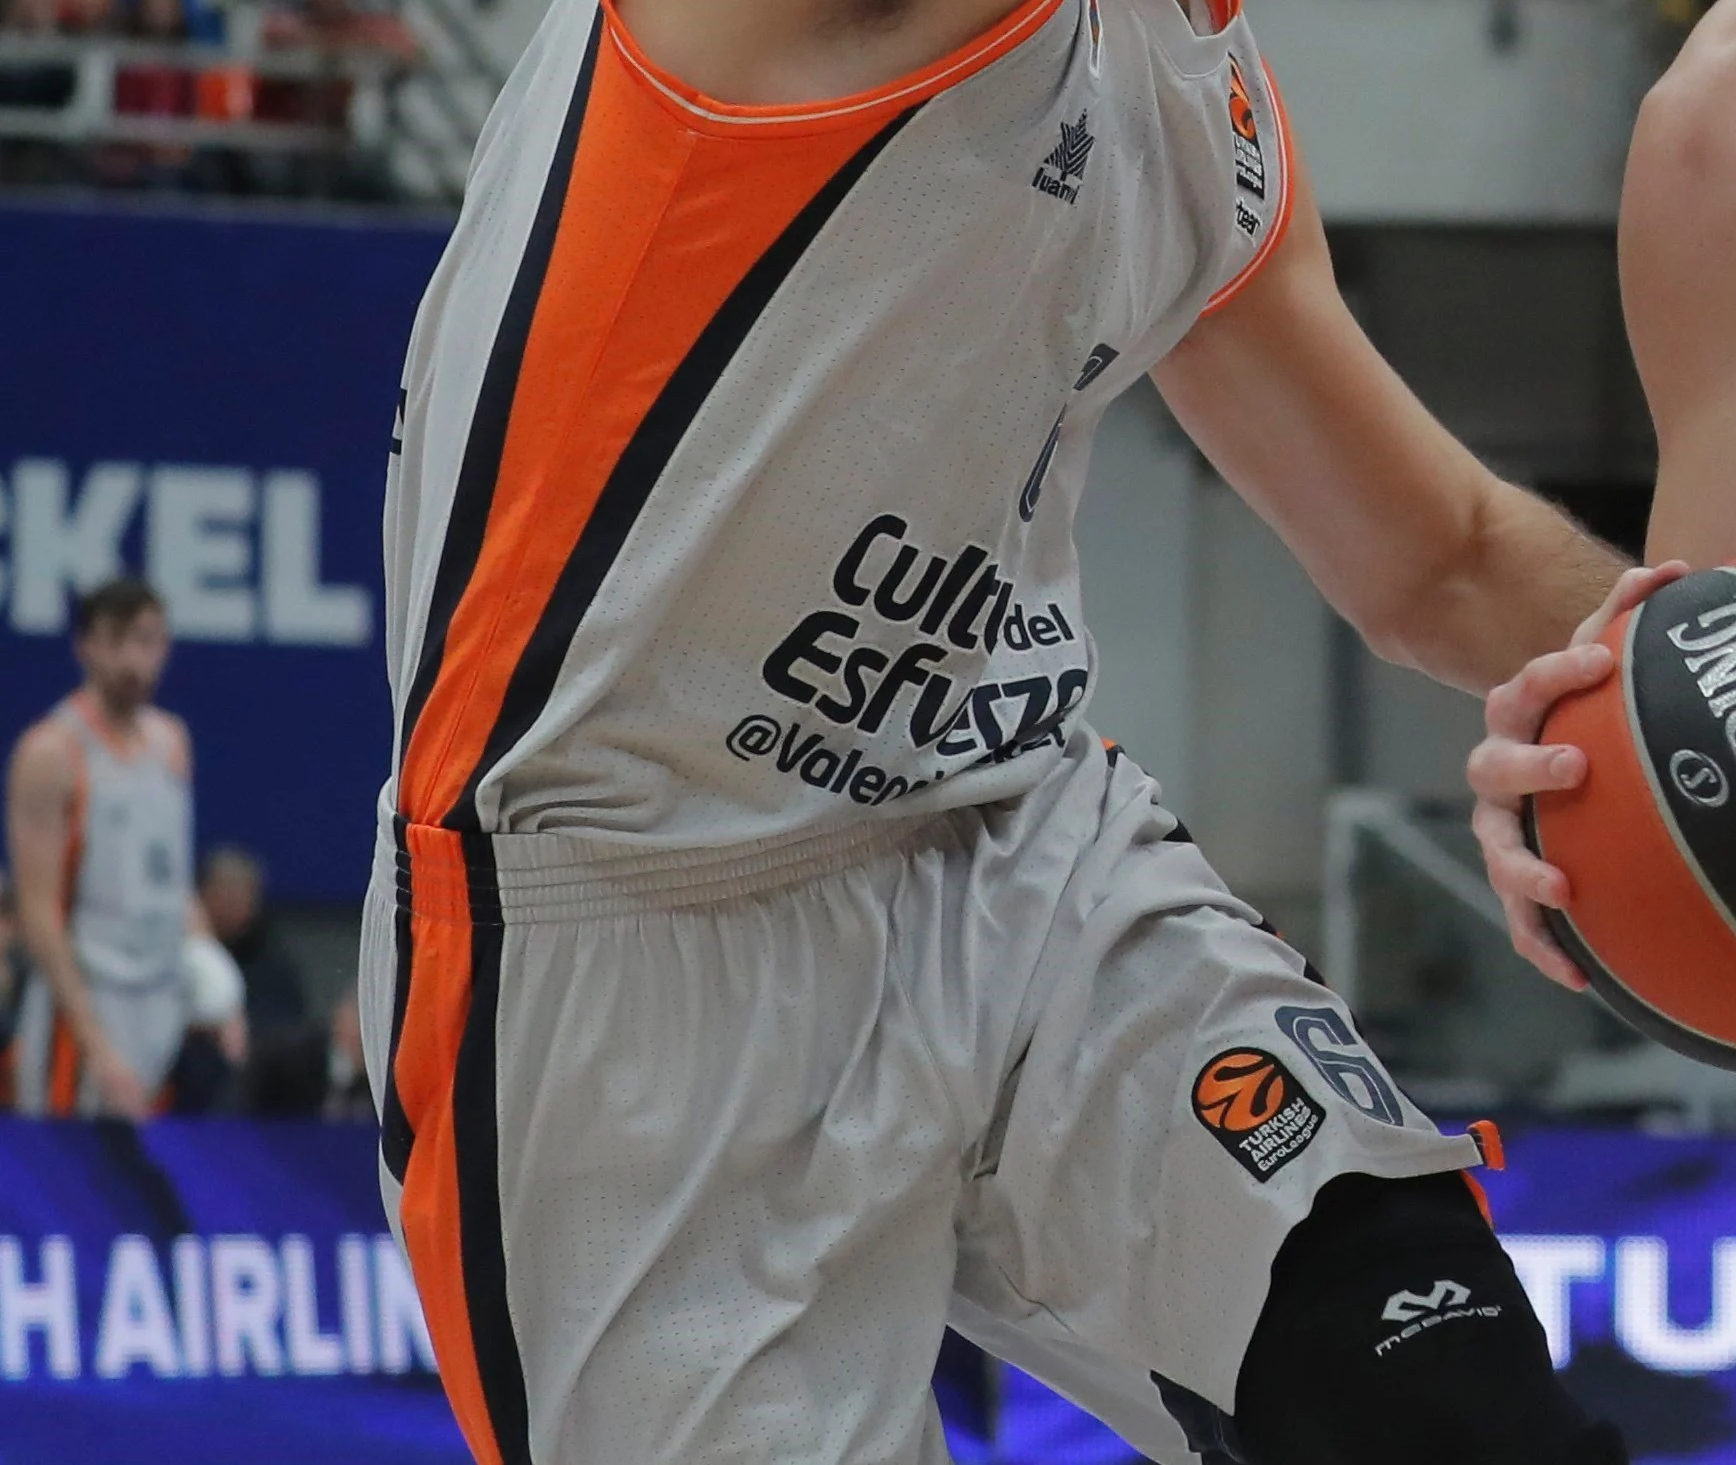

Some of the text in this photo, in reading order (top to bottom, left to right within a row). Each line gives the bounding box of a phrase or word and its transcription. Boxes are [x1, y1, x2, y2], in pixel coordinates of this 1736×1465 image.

[0, 457, 374, 649] KEL
[1004, 603, 1075, 651] del
[1274, 1005, 1403, 1127] 6
[1239, 1097, 1305, 1151] TURKISH
[1250, 1106, 1312, 1163] AIRLINES
[1257, 1114, 1319, 1172] EuroLeague
